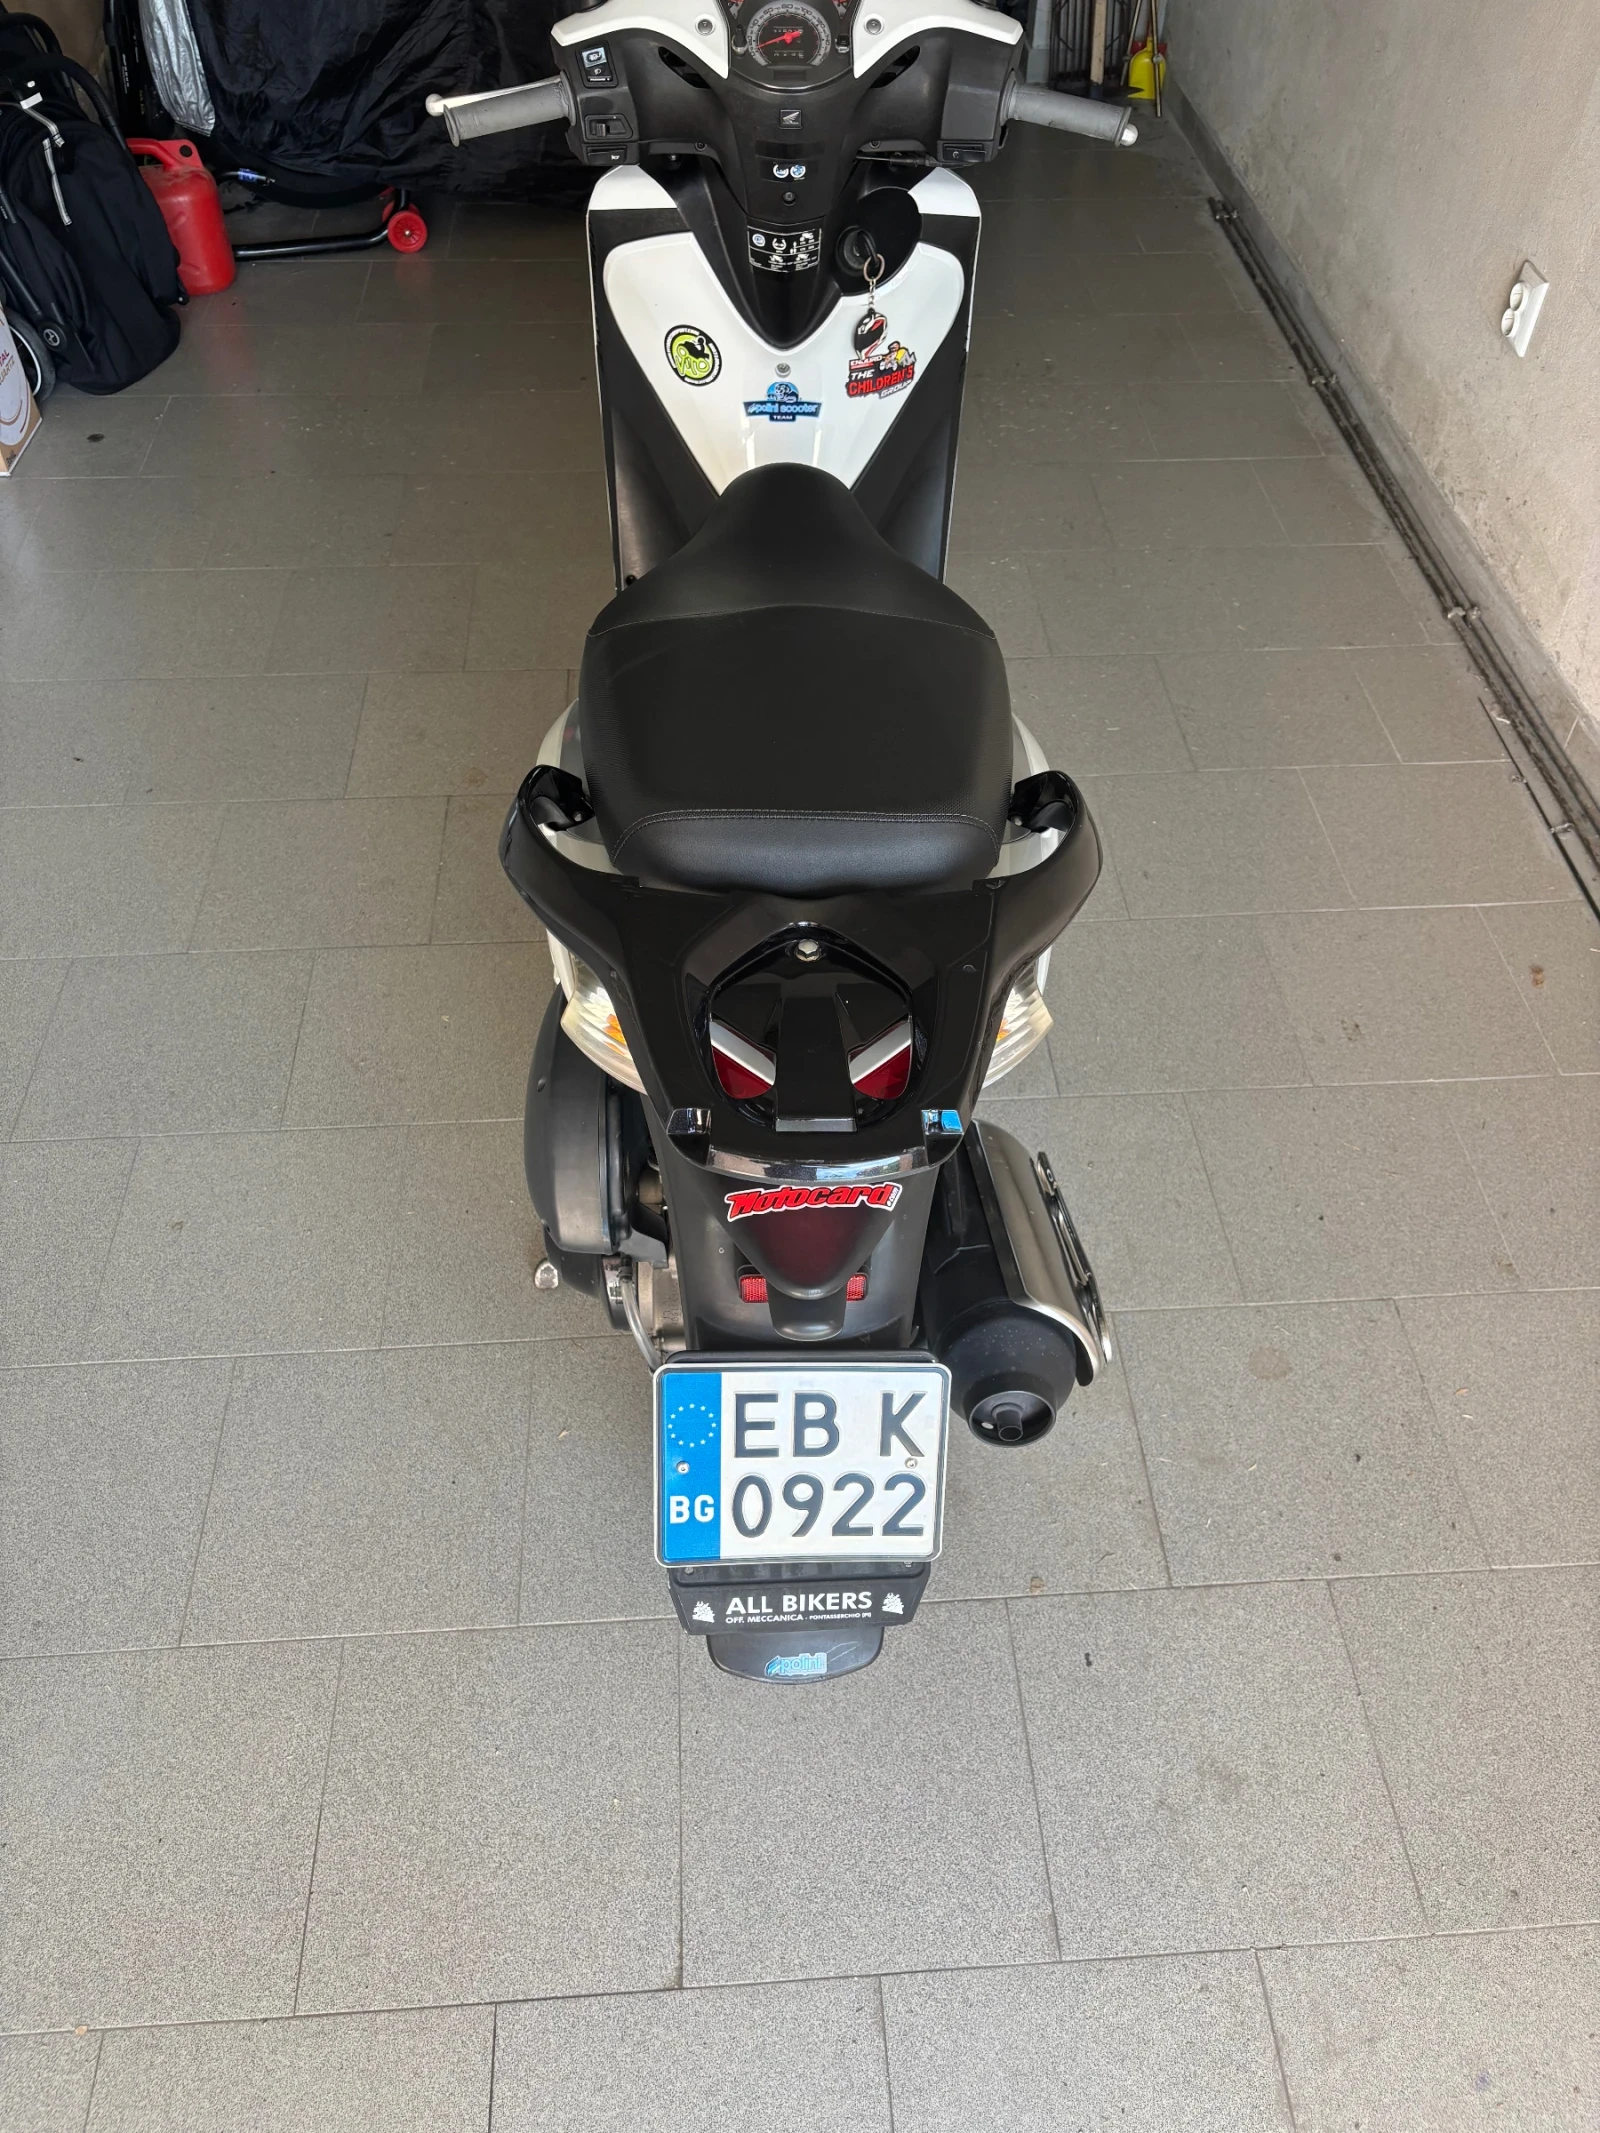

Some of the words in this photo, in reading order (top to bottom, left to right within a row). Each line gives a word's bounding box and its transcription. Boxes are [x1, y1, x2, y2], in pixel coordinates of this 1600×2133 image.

[848, 365, 914, 395] CHILDREN'S
[851, 369, 875, 380] THE
[780, 403, 819, 413] scooter
[726, 1184, 894, 1219] Motocard
[735, 1393, 840, 1458] EB
[880, 1393, 926, 1458] K
[669, 1495, 715, 1524] BG
[733, 1473, 927, 1538] 0922
[725, 1597, 773, 1615] ALL
[782, 1591, 872, 1612] BIKERS
[725, 1616, 745, 1624] OFF.
[747, 1614, 804, 1623] MECCANICA
[780, 1656, 822, 1673] polini
